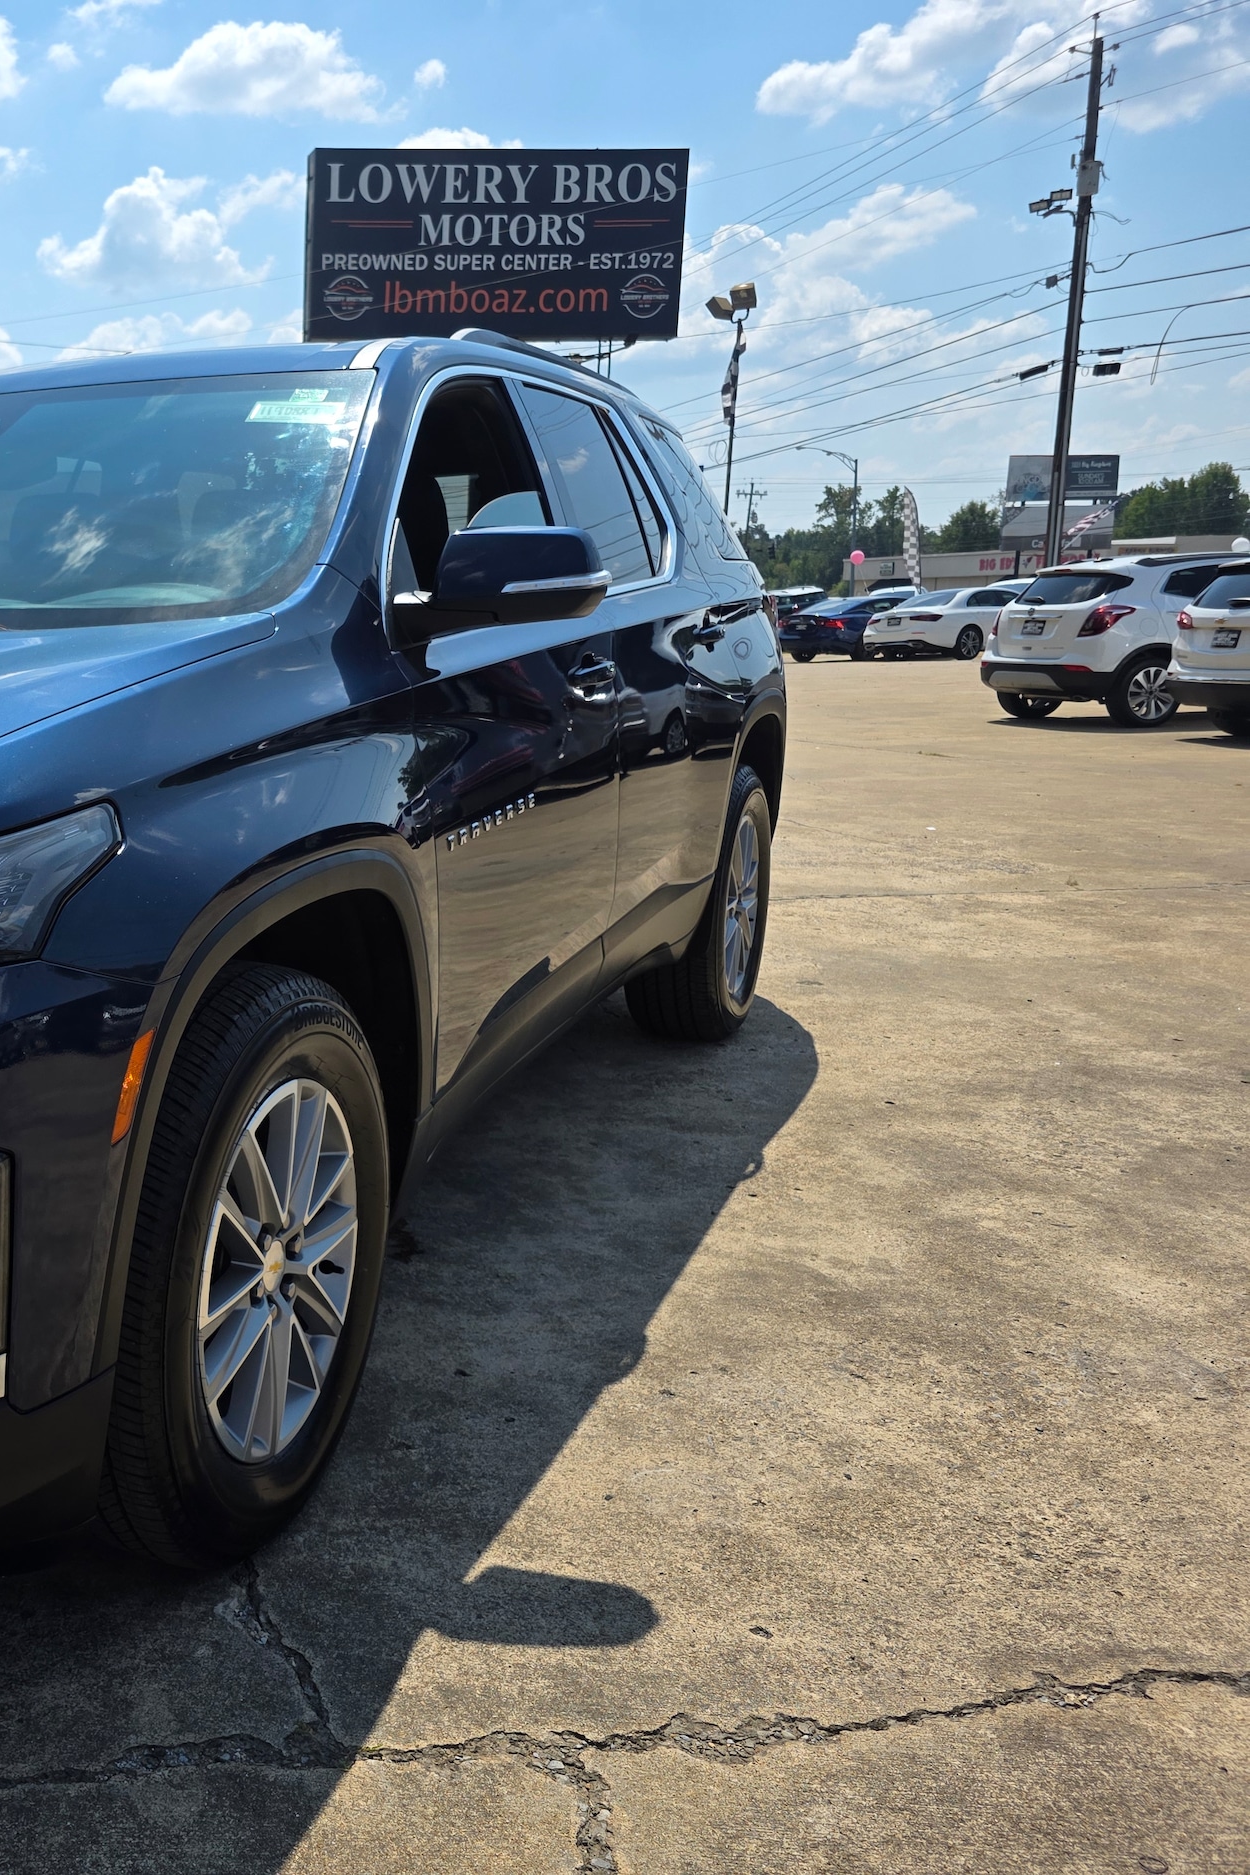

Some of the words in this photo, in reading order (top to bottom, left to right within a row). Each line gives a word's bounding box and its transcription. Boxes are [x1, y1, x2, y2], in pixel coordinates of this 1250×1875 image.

[326, 163, 539, 204] LOWERY
[551, 162, 677, 203] BROS
[418, 213, 586, 246] MOTORS
[321, 254, 428, 271] PREOWNED
[433, 253, 495, 271] SUPER
[501, 253, 572, 270] CENTER
[589, 252, 674, 270] EST.1972
[383, 280, 608, 313] lbmboaz.com
[979, 558, 996, 571] BIG
[447, 793, 535, 851] TRAVERSE
[293, 1004, 363, 1050] BRIDGESTONE
